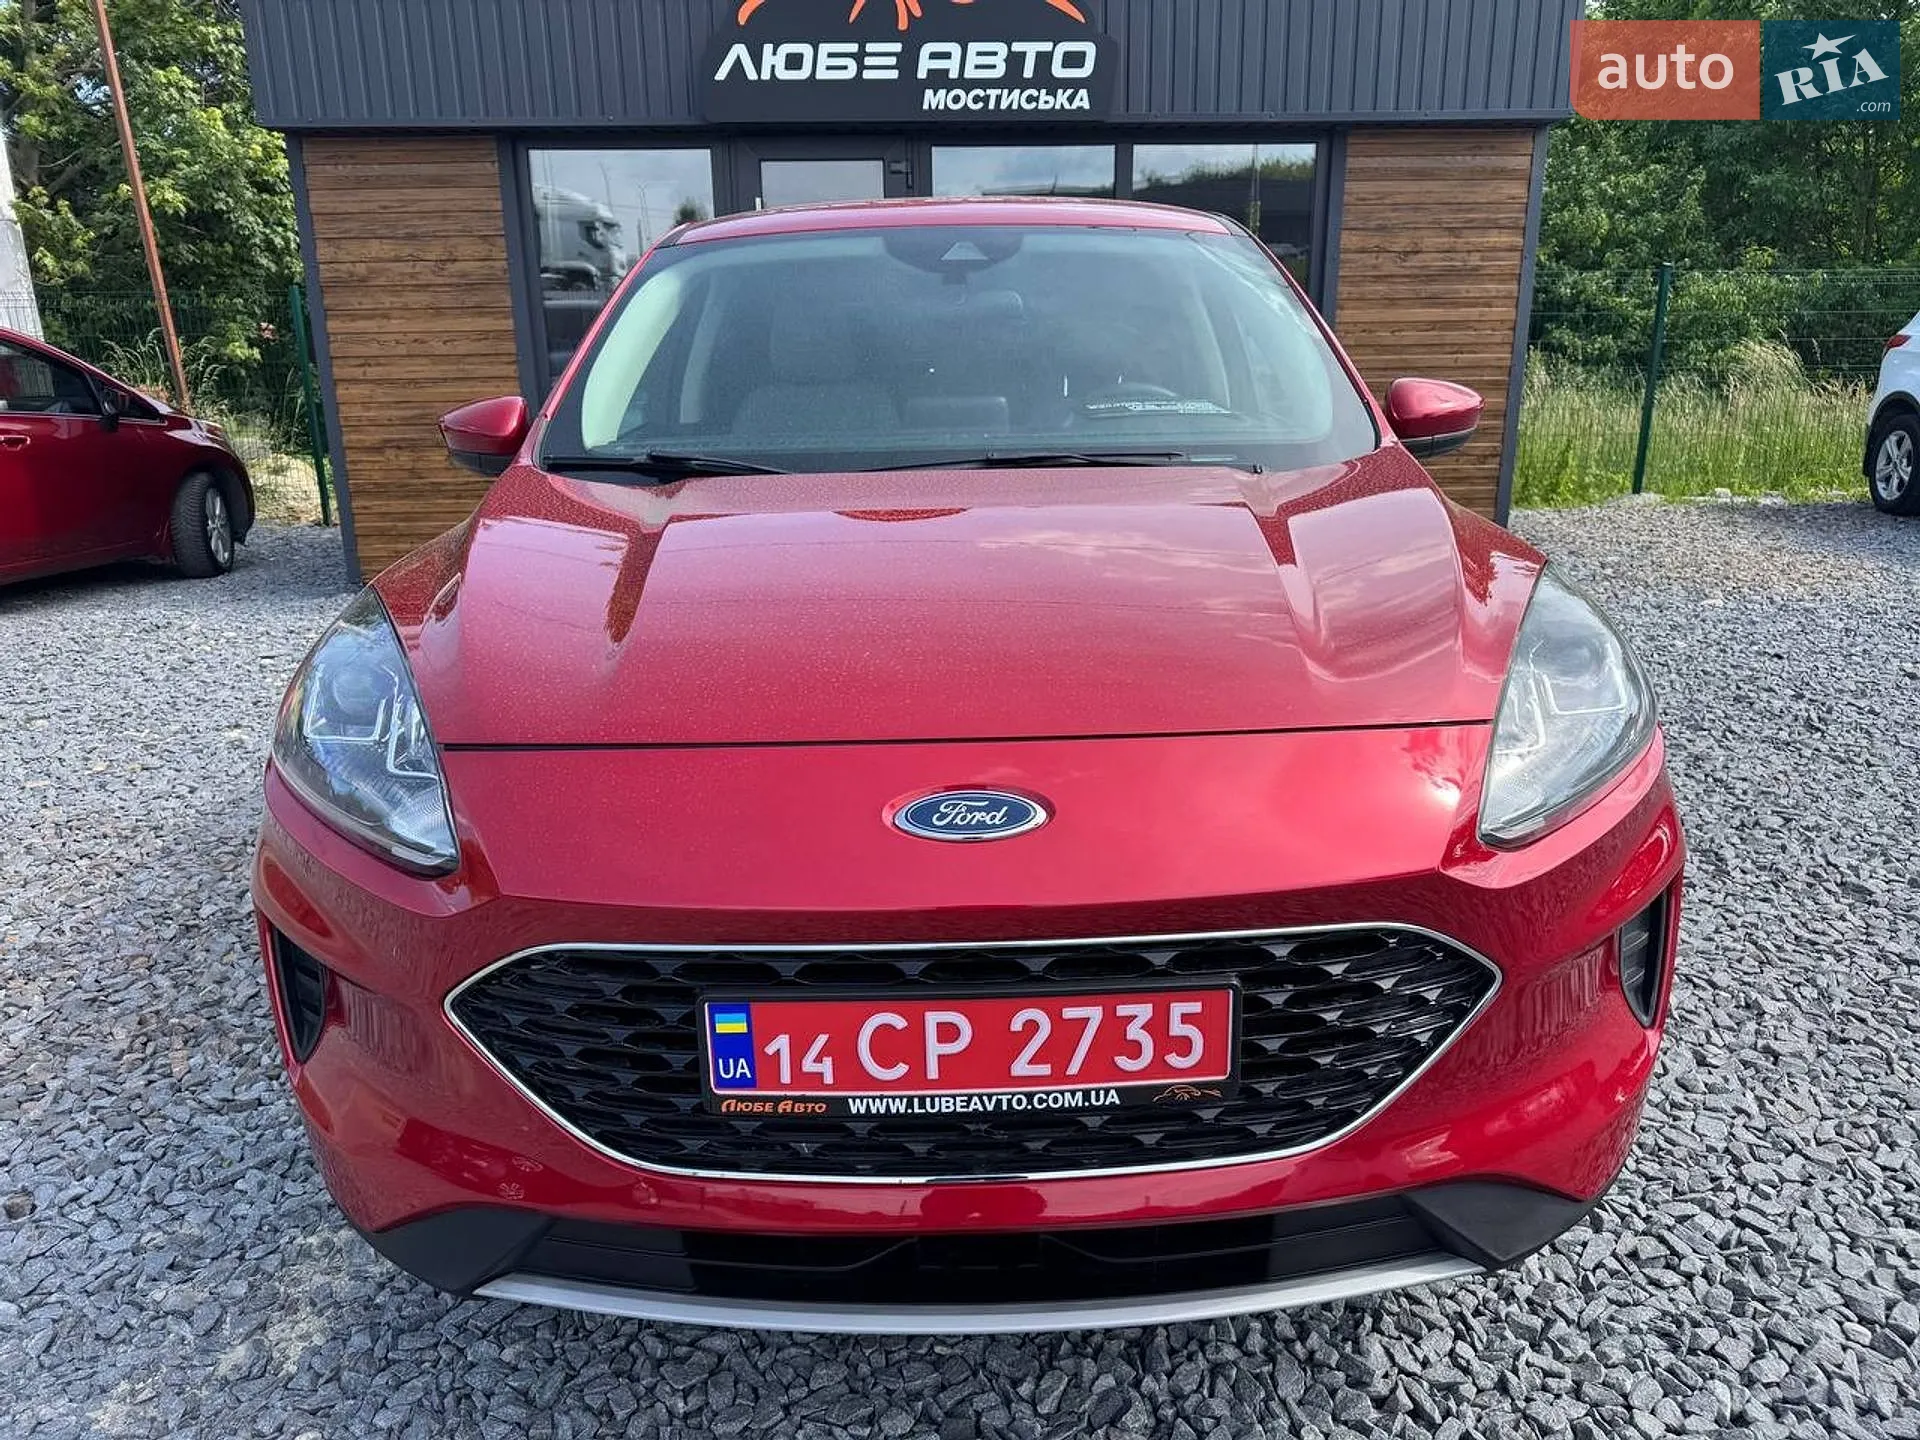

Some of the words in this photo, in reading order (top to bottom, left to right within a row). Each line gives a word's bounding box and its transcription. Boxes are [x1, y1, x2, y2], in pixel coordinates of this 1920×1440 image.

[713, 42, 902, 81] ЛЮБЕ
[915, 41, 1097, 80] АВТО
[922, 88, 1091, 110] МОСТИСЬКА
[931, 800, 1008, 826] Ford
[1009, 1002, 1204, 1078] 2735
[718, 1058, 752, 1079] UA
[847, 1088, 1120, 1115] WWW.LUBEAVTO.COM.UA
